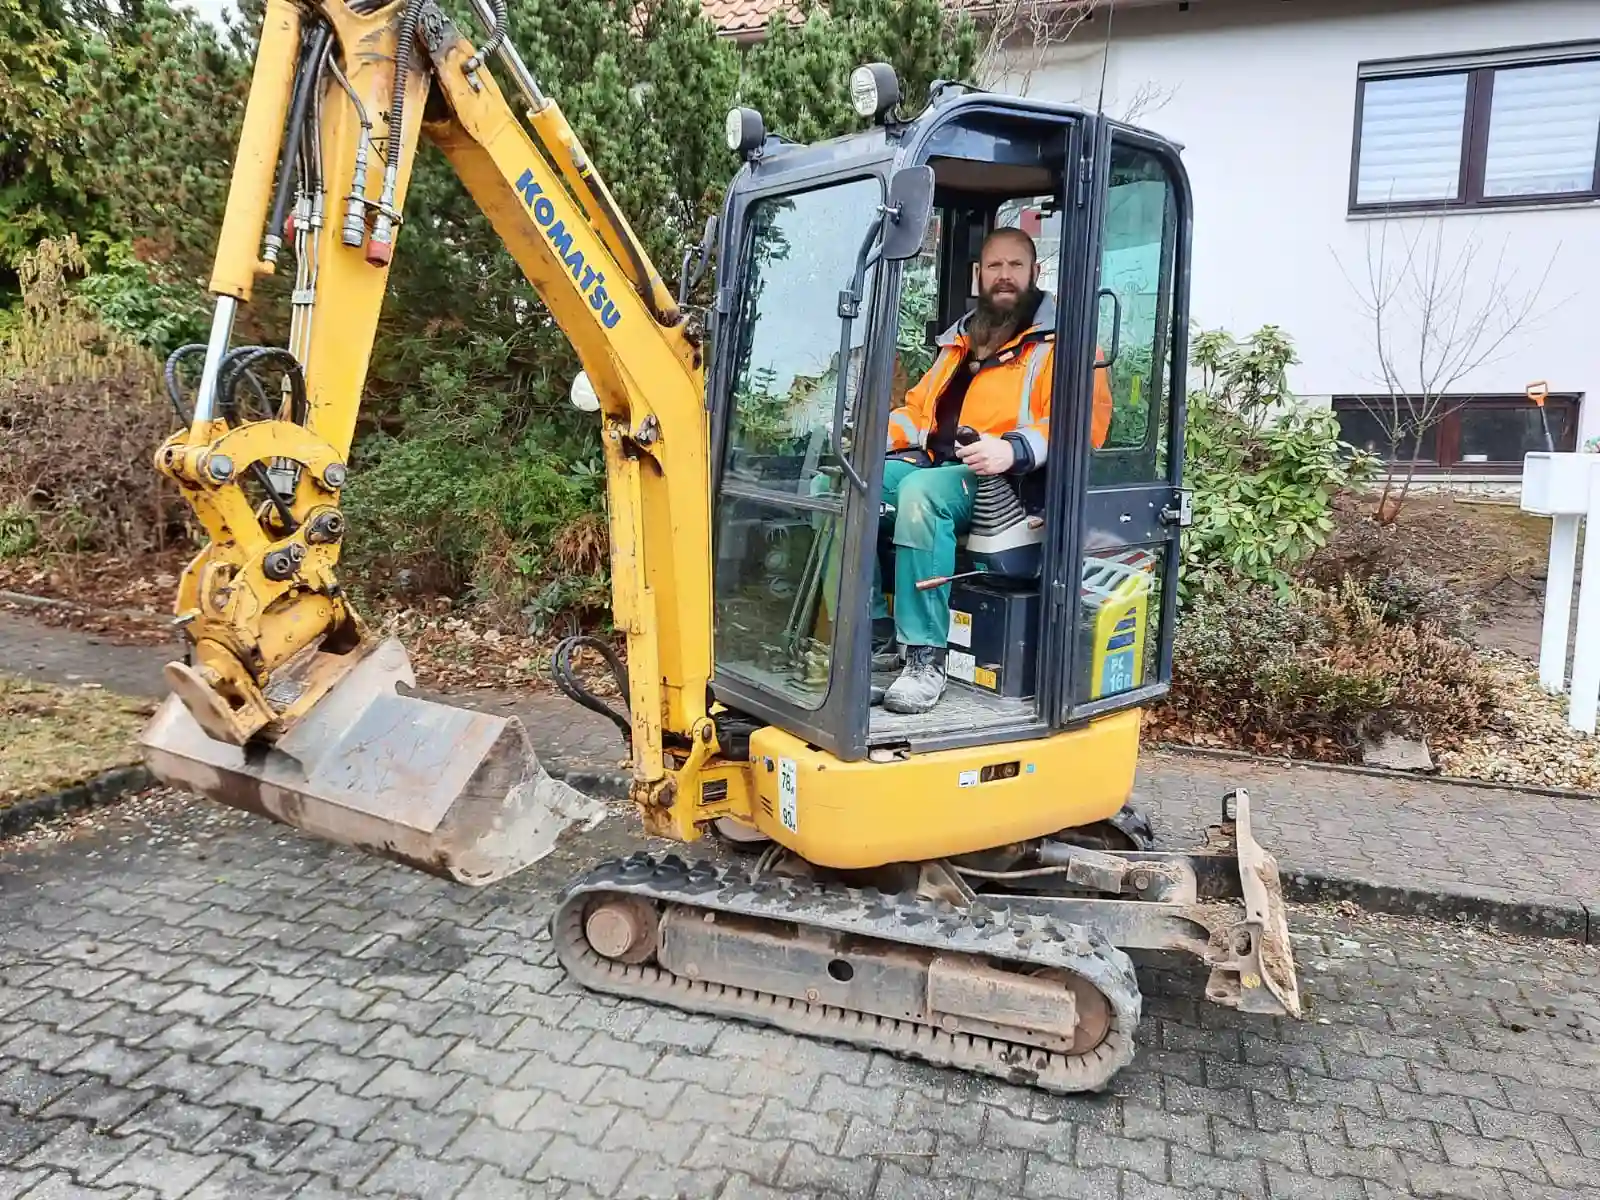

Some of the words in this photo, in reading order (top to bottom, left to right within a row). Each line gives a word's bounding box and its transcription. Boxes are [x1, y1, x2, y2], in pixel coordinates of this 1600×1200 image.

[515, 168, 621, 328] KOMATSU
[1111, 655, 1124, 671] PC
[782, 771, 791, 792] 78
